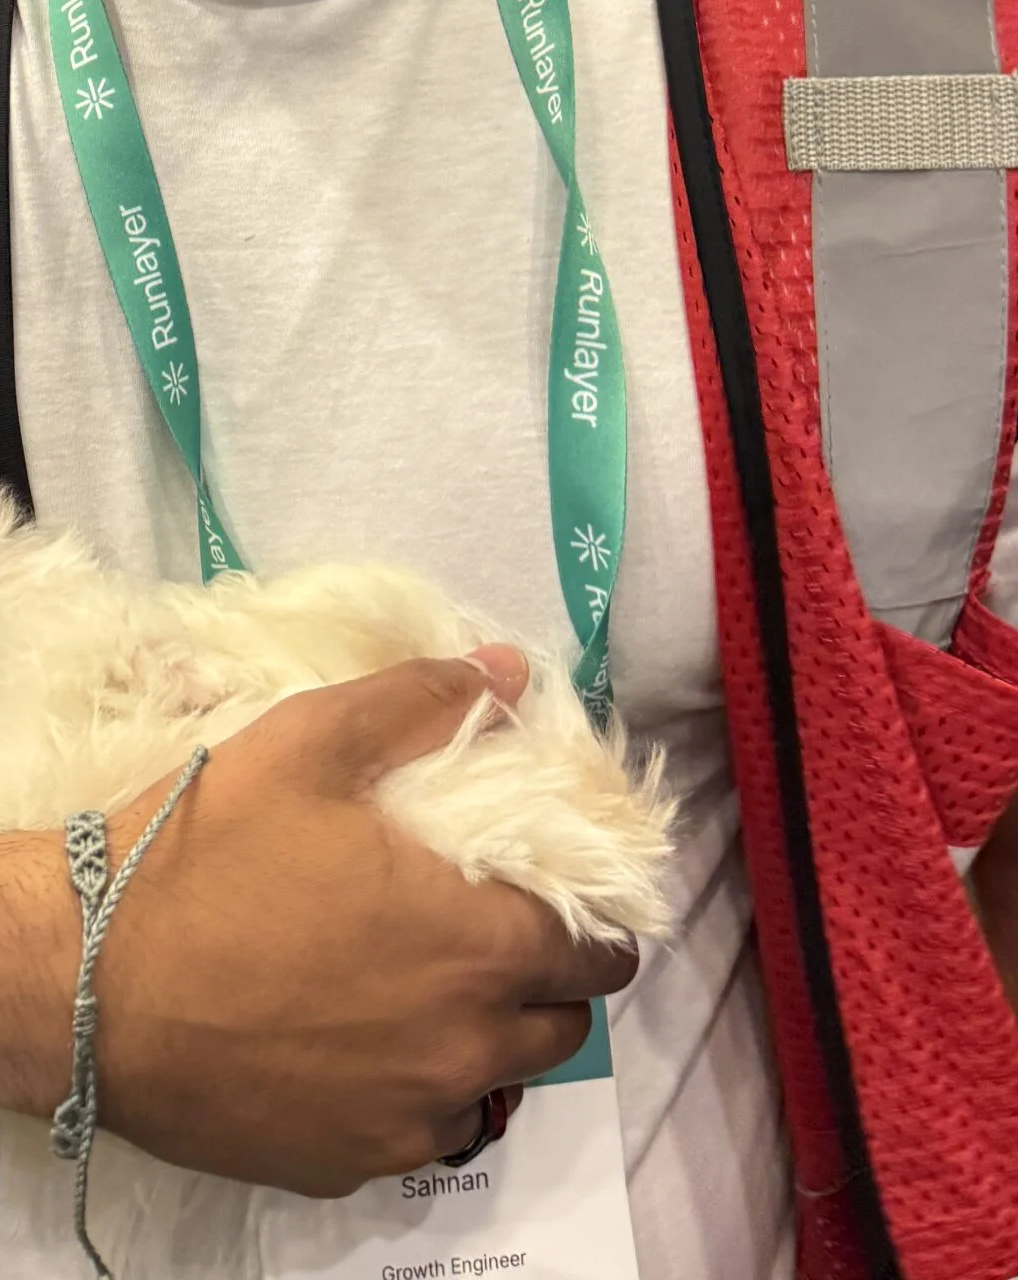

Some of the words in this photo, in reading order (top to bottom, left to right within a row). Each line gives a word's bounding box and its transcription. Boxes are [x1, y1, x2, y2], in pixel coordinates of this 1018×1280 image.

[119, 204, 178, 350] Runlayer
[564, 268, 608, 428] Runlayer
[401, 1172, 489, 1199] Sahnan
[382, 1259, 445, 1280] Growth
[451, 1252, 527, 1276] Engineer
